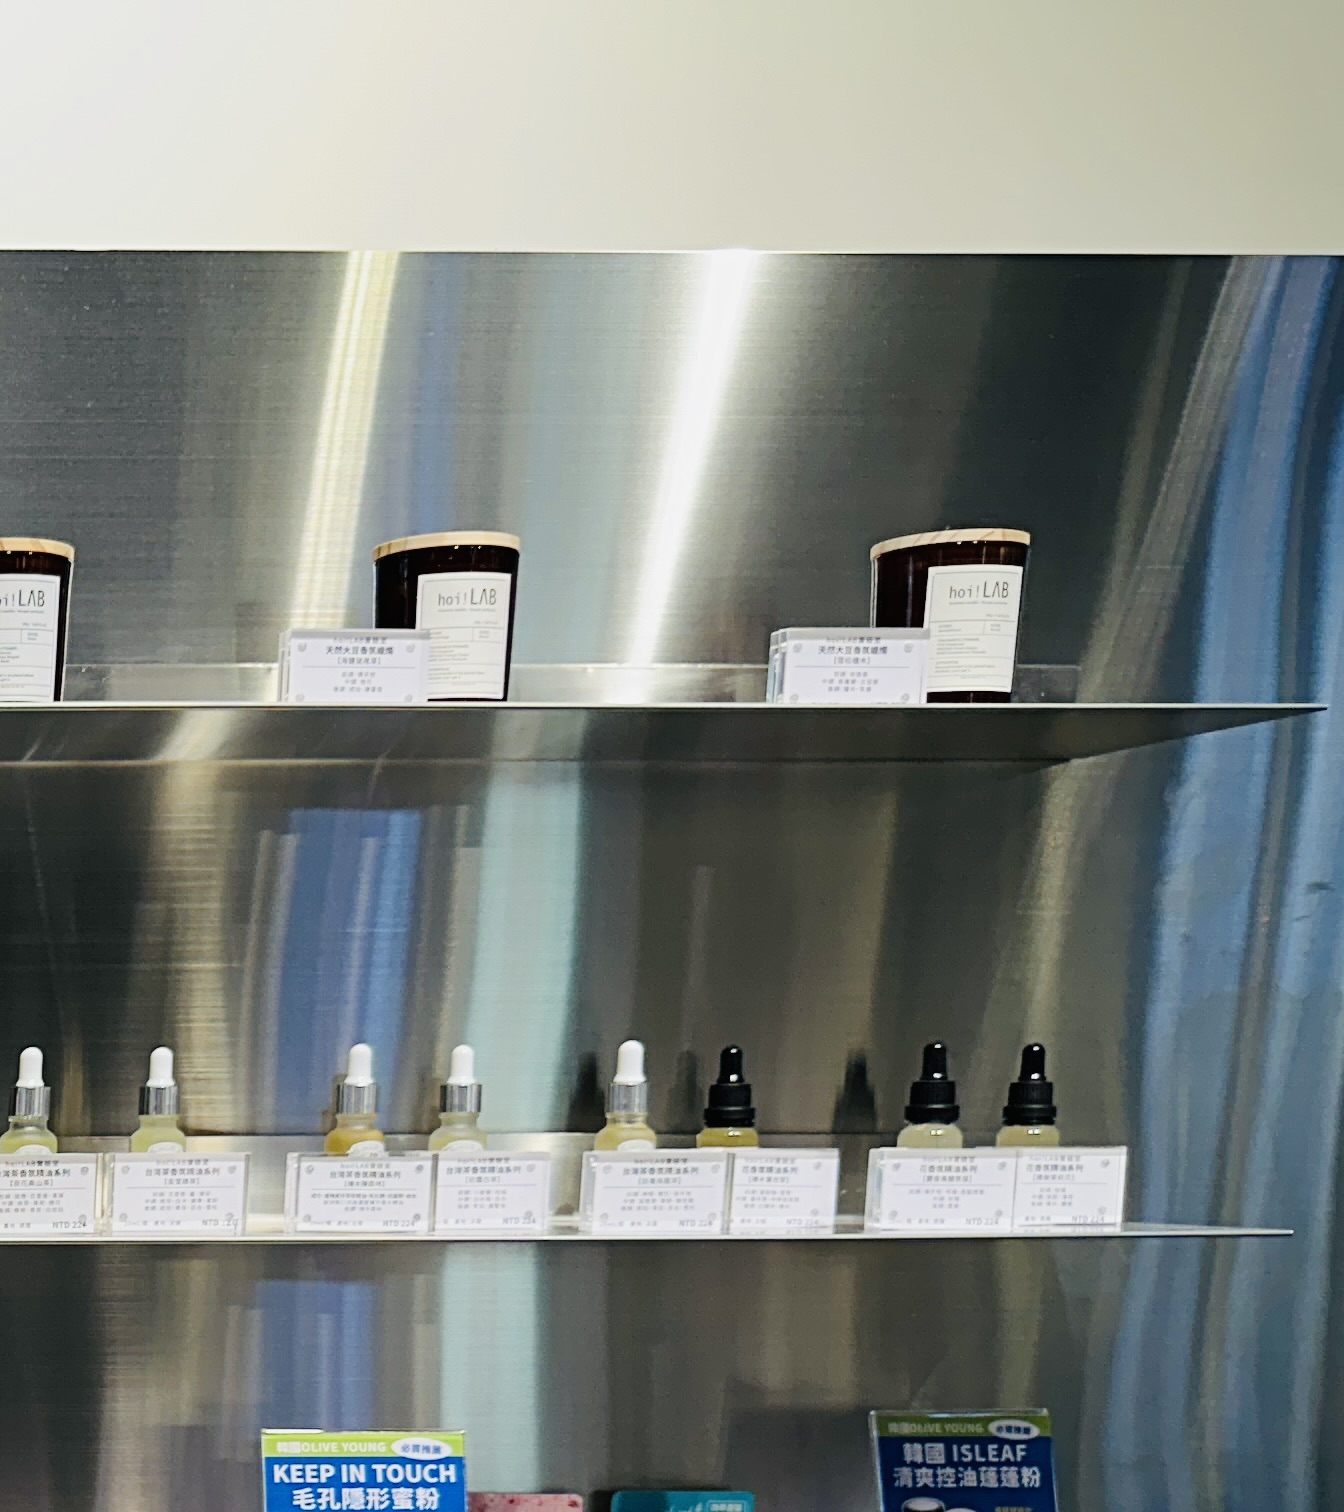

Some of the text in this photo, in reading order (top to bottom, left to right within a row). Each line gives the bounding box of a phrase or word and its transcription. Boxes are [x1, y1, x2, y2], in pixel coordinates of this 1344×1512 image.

[341, 1442, 386, 1453] YOUNG
[902, 1443, 1027, 1464] 韓國 ISLEAF
[273, 1464, 457, 1484] KEEP IN TOUCH
[292, 1487, 440, 1511] 毛孔隱形蜜粉
